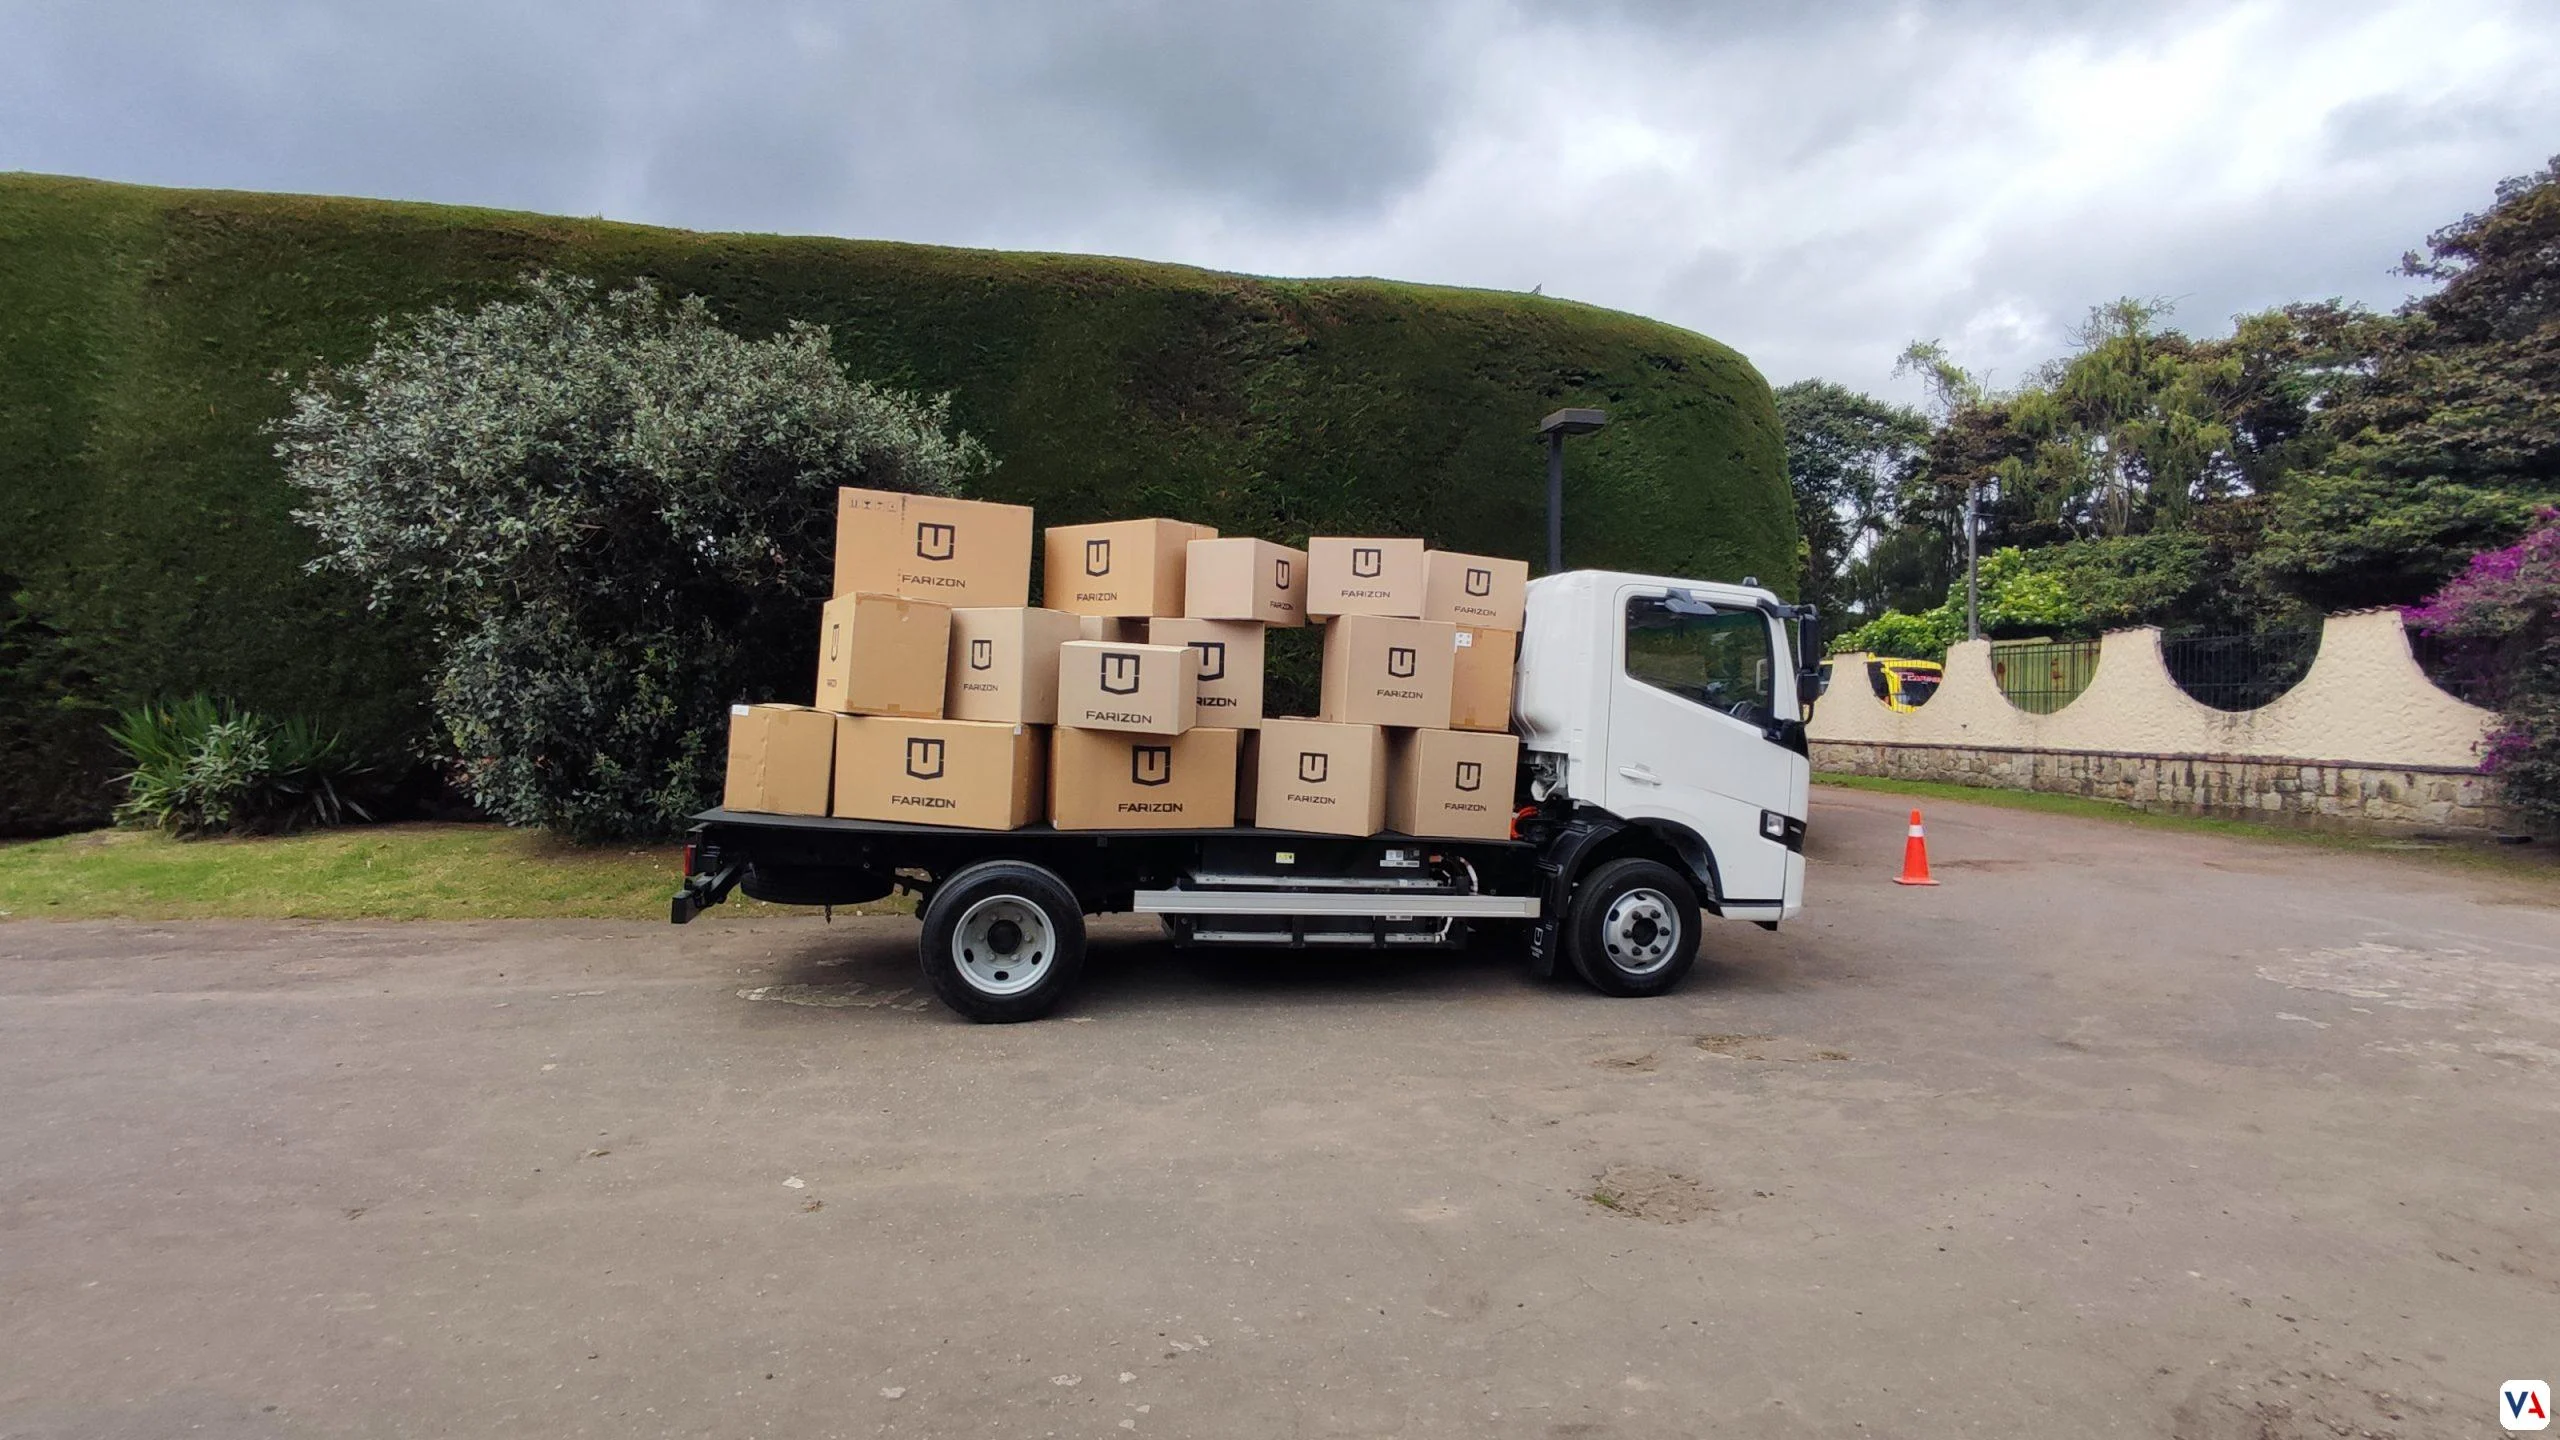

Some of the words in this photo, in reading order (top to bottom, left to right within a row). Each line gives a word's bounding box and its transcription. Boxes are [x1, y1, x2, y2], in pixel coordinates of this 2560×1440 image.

[901, 574, 966, 589] FARIZON
[1076, 592, 1118, 602] FARIZON
[1341, 589, 1391, 599] FARIZON
[1454, 605, 1497, 617] FARIZON
[963, 682, 998, 692] FARIZON
[1377, 689, 1424, 700] FARIZON
[1196, 696, 1237, 707] RIZON
[1086, 710, 1152, 725] FARIZON
[892, 795, 956, 809] FARIZON
[1288, 794, 1336, 805] FARIZON
[1118, 803, 1183, 813] FARIZON
[1444, 802, 1487, 812] FARIZON
